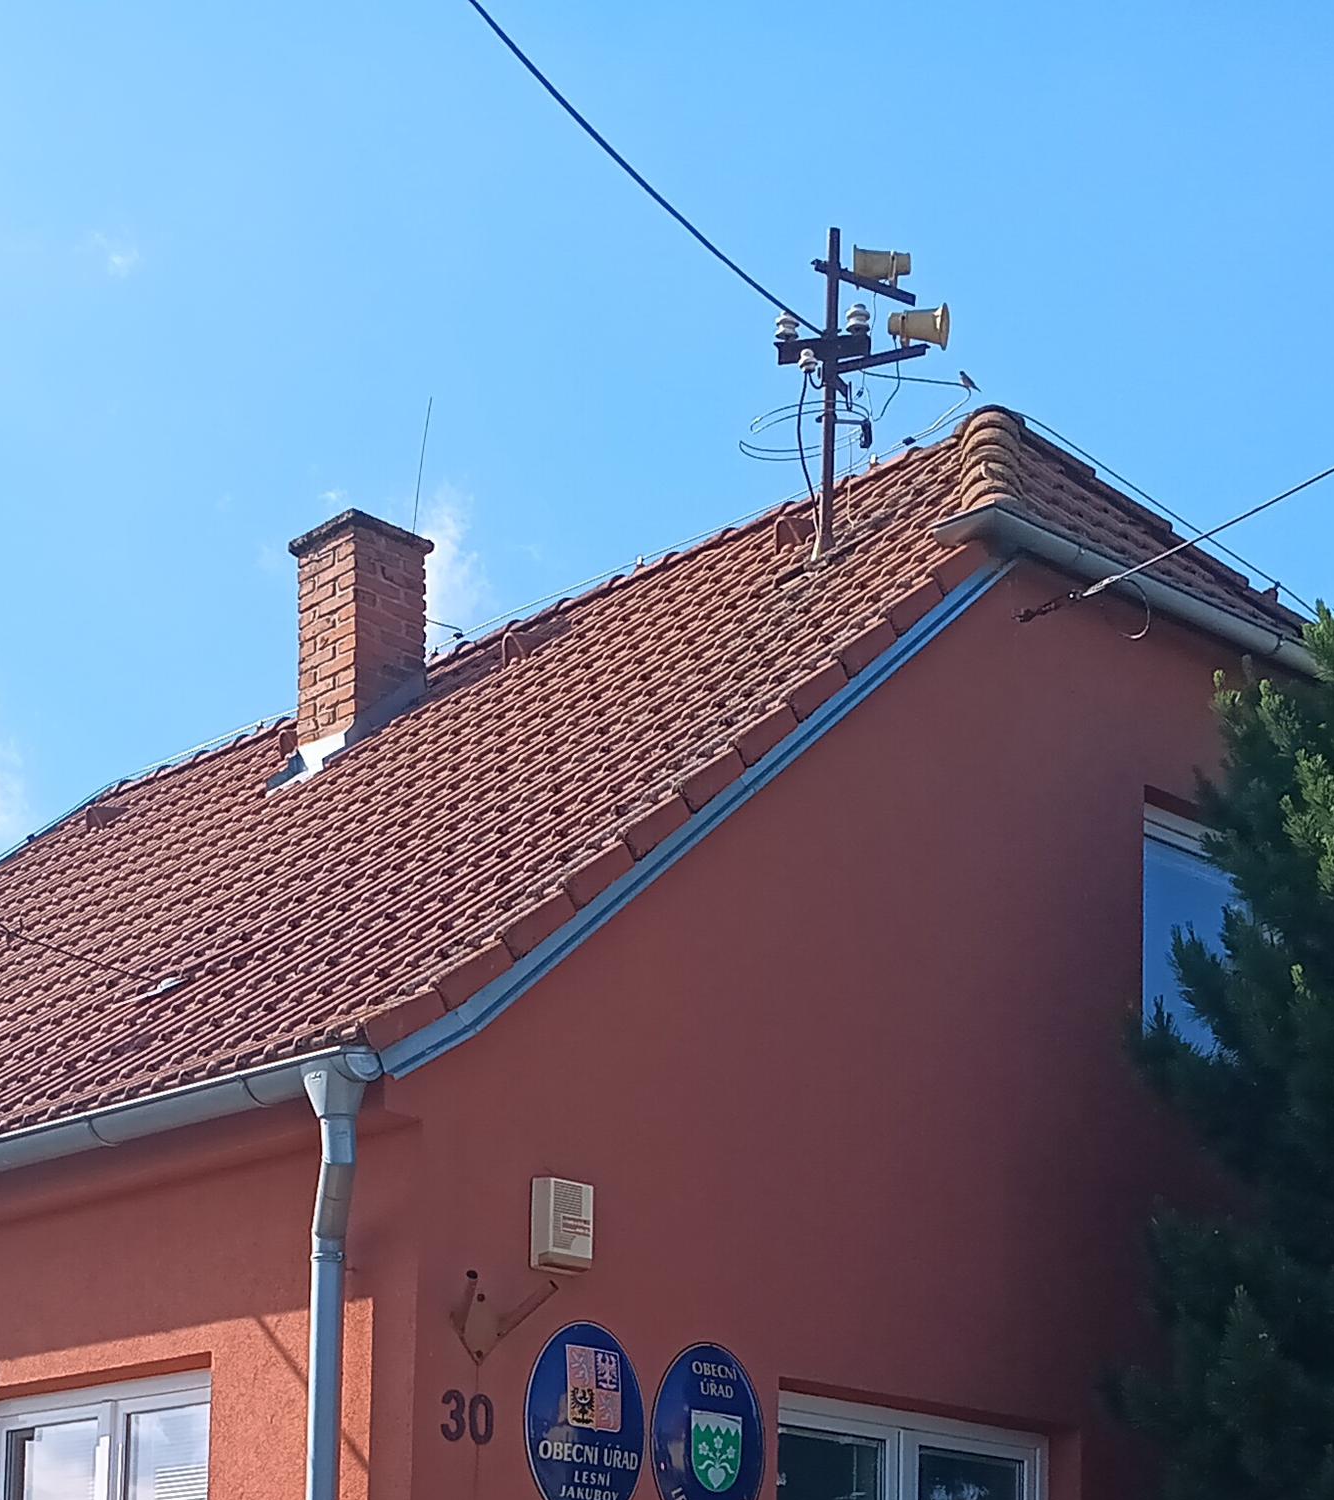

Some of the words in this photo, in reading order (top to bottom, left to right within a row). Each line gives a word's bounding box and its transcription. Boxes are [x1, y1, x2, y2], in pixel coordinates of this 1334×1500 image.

[692, 1361, 737, 1380] OBECNÍ
[700, 1378, 734, 1399] ÚŘAD
[441, 1389, 494, 1445] 30
[538, 1440, 600, 1466] OBECNÍ
[603, 1443, 639, 1471] ÚŘAD
[574, 1470, 611, 1487] LESNÍ
